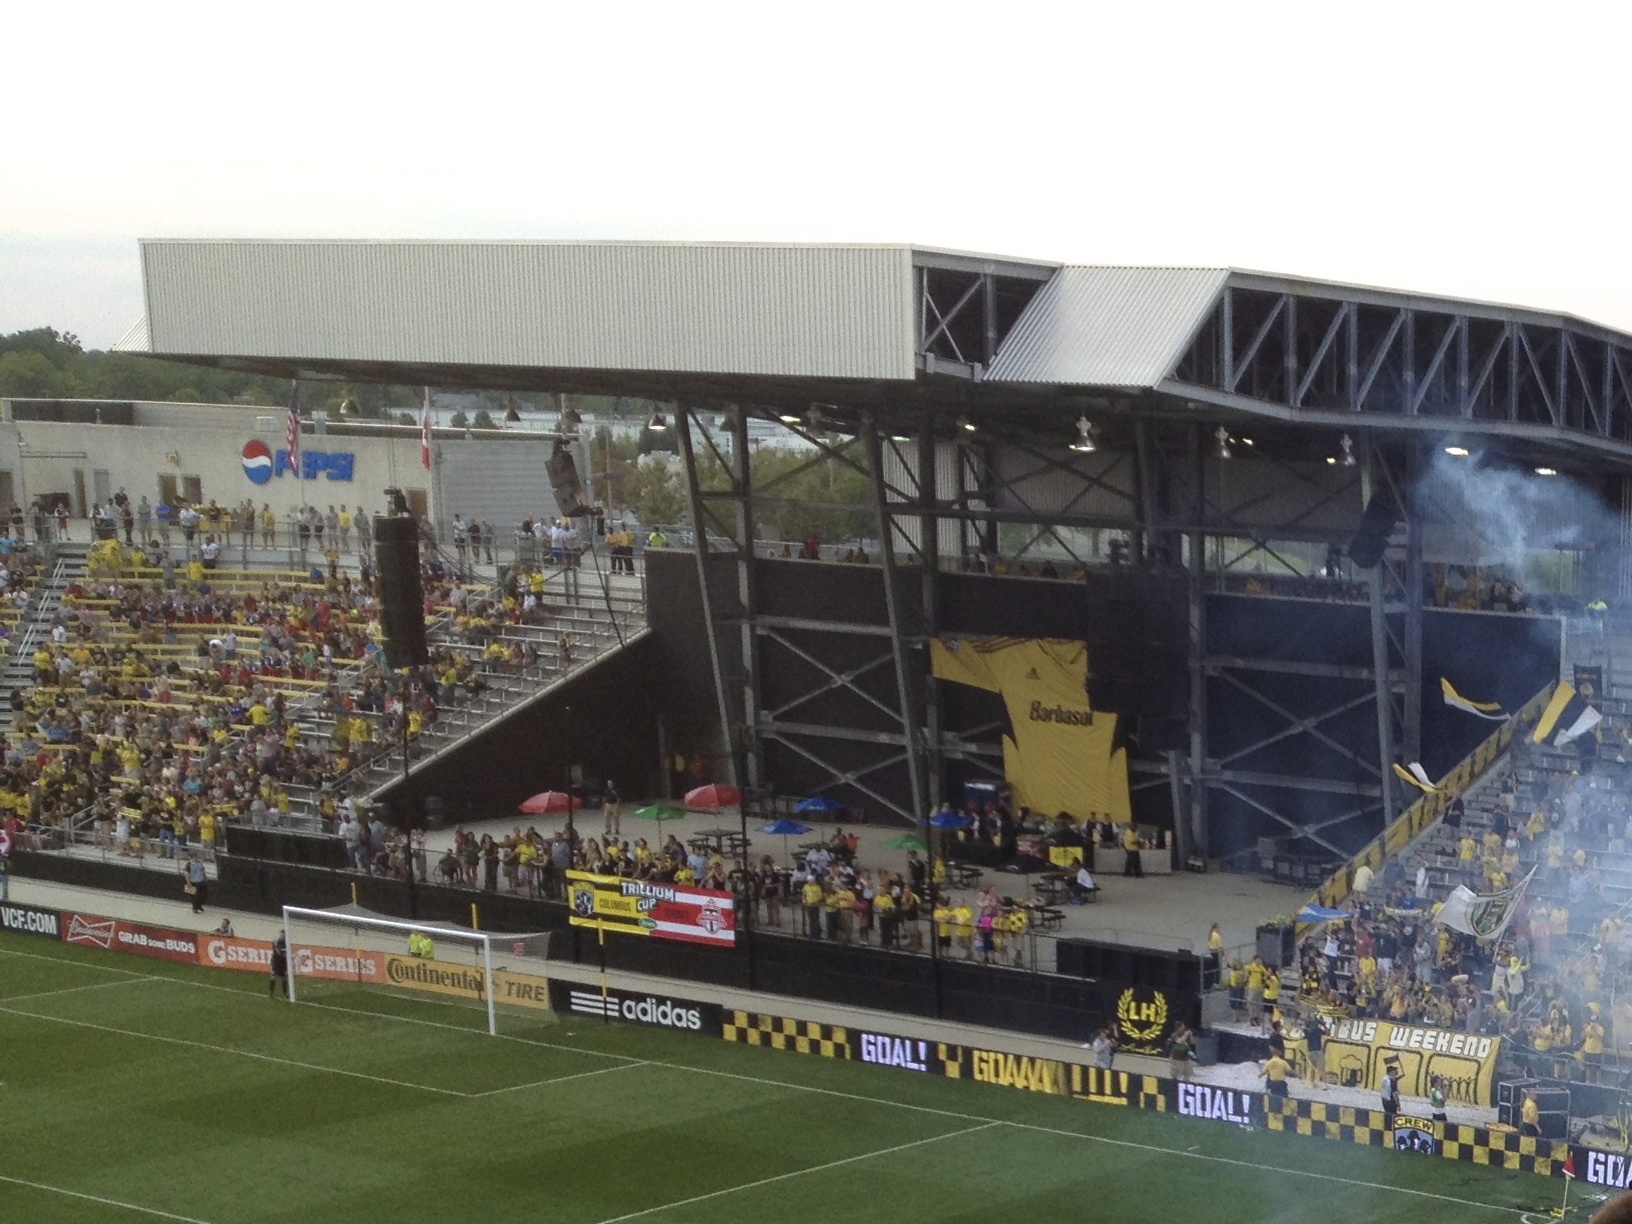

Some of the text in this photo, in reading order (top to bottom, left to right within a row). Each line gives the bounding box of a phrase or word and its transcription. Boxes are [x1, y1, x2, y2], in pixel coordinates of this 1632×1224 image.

[1029, 700, 1094, 727] Barbasol
[621, 882, 674, 902] TRILLIUM
[638, 899, 656, 911] CUP
[118, 931, 147, 946] GRAB
[166, 938, 196, 954] BUDS
[207, 940, 272, 964] G SERI
[295, 949, 313, 973] G
[505, 980, 545, 1002] TIRE
[622, 997, 701, 1029] adidas
[1129, 1001, 1156, 1021] LH
[861, 1033, 928, 1072] GOAL!
[1389, 1026, 1493, 1059] WEEKEND
[1178, 1082, 1250, 1124] GOAL!
[1394, 1116, 1433, 1132] CREW
